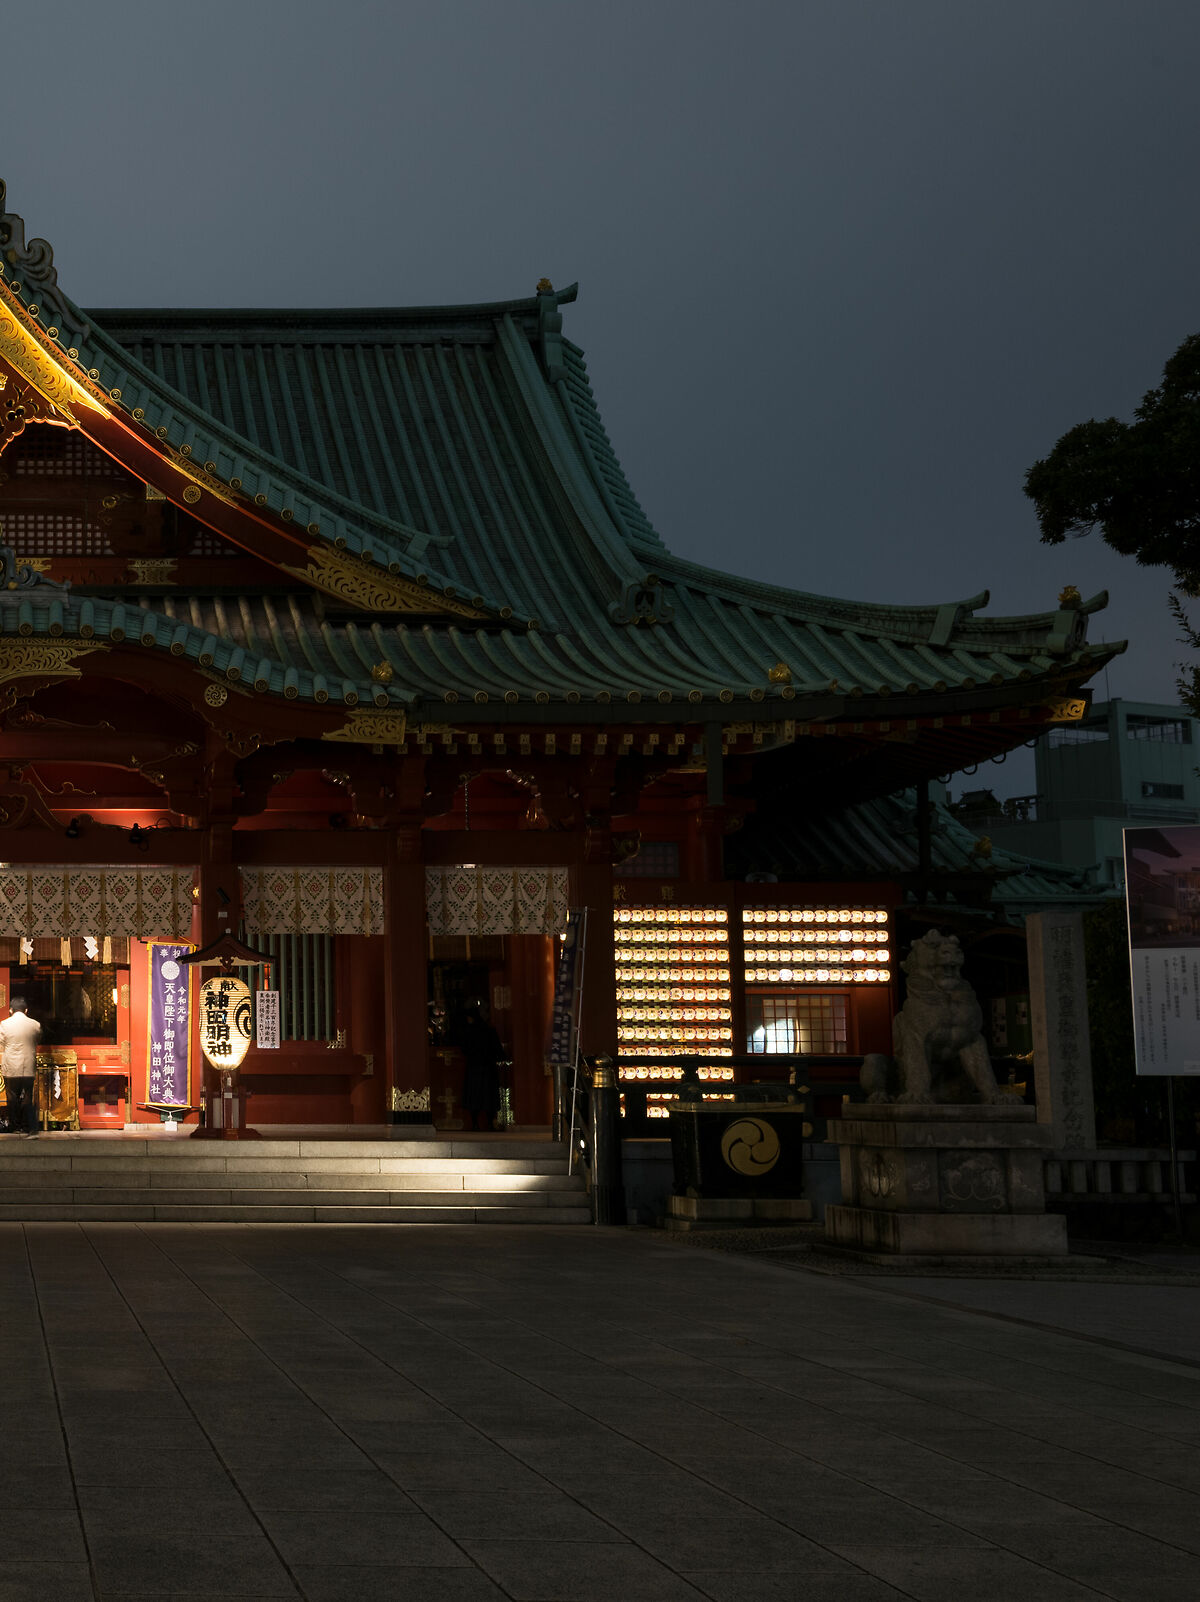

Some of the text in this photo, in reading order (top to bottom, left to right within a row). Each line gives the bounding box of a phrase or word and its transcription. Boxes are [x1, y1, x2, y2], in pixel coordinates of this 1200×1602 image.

[177, 986, 187, 1024] 令和元年
[205, 991, 232, 1058] 神田明神
[151, 1042, 162, 1095] 神田神社
[162, 983, 176, 1100] 天皇陛下御即位御大典
